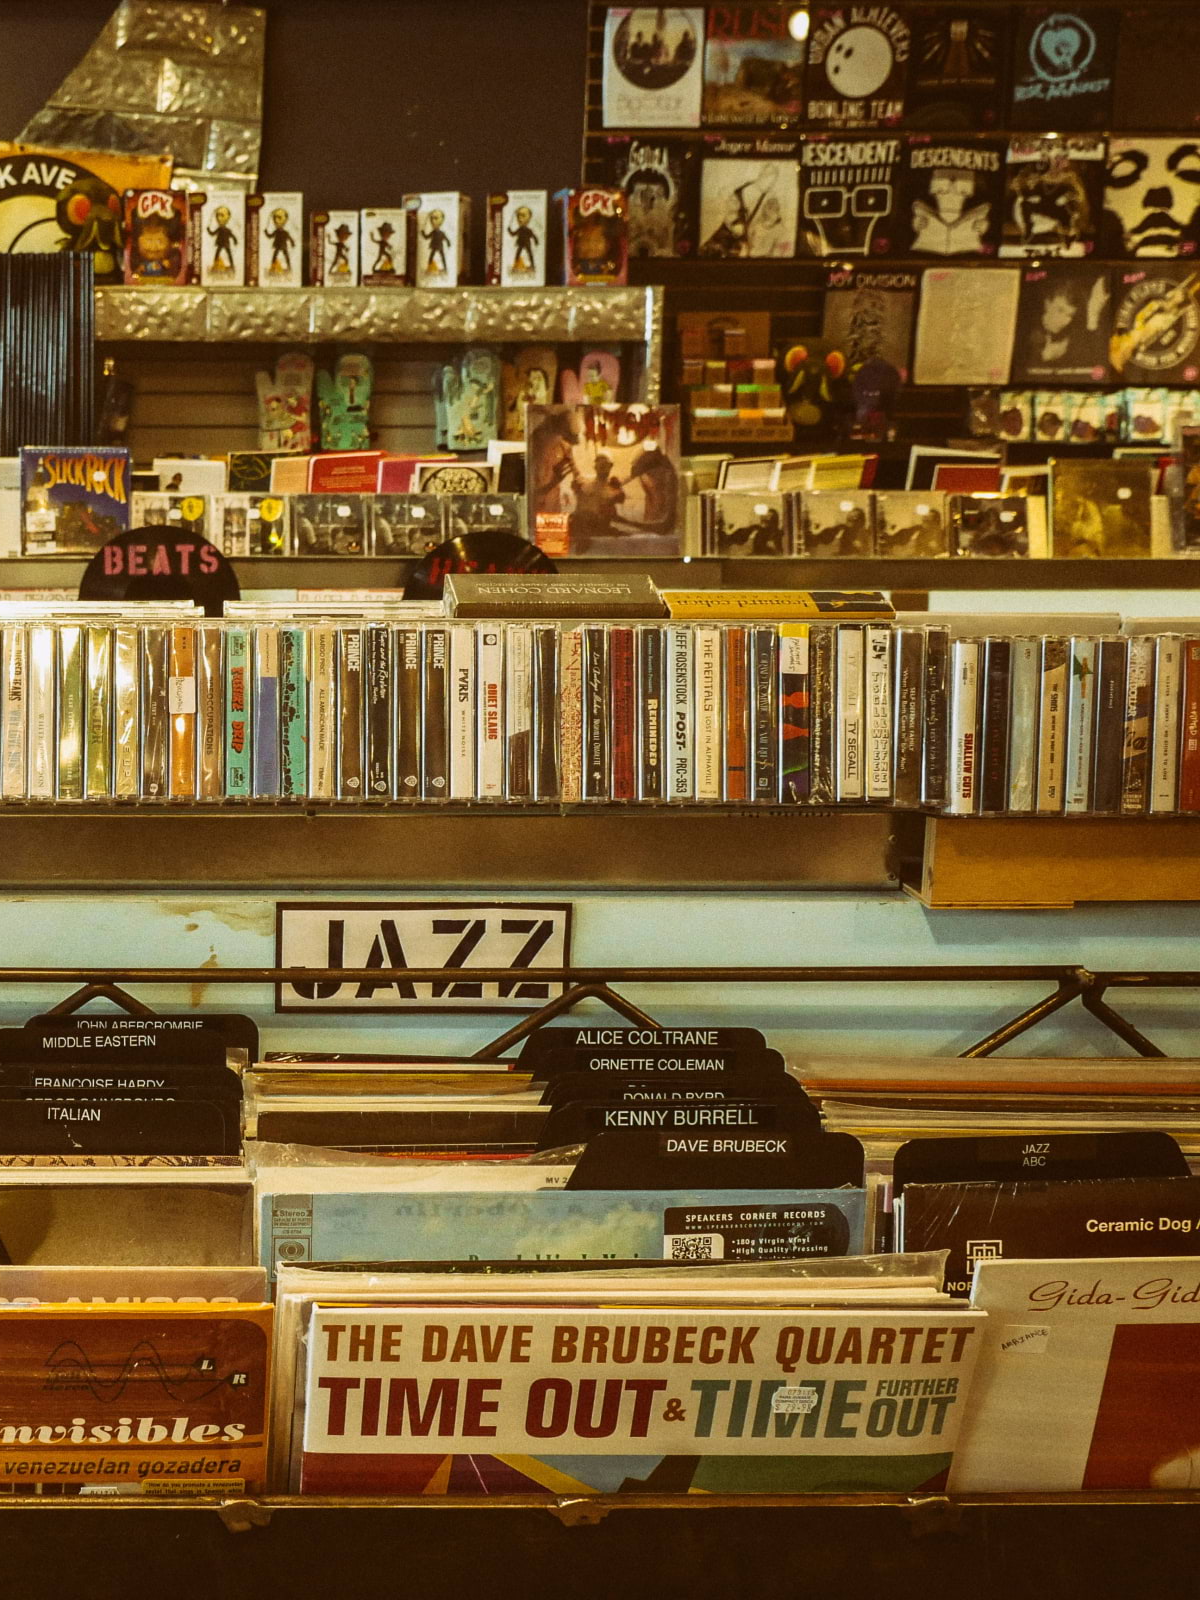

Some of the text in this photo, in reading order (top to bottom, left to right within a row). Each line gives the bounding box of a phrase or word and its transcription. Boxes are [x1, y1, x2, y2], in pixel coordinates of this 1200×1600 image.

[910, 146, 1000, 172] DESCENDENTS
[22, 162, 78, 190] AVE
[826, 271, 916, 287] JOY DIVISION
[104, 544, 219, 576] BEATS
[478, 586, 541, 594] COHEN
[348, 634, 359, 671] PRINCE
[405, 633, 416, 670] PRINCE
[433, 634, 444, 669] PRINCE
[703, 639, 713, 658] THE
[8, 679, 22, 701] JEANS
[459, 668, 469, 703] PVRIS
[703, 662, 713, 712] RENTALS
[488, 684, 497, 740] QUIET SLANG
[676, 631, 687, 793] JEFF ROSENSTOCK PRC-353
[1050, 694, 1058, 712] SHINS
[231, 721, 245, 754] DRIP
[848, 722, 856, 778] TY SEGALL
[963, 733, 972, 798] SHALLOW CUTS
[290, 919, 554, 1000] JAZZ
[42, 1035, 156, 1049] MIDDLE EASTERN
[576, 1031, 718, 1045] ALICE COLTRANE
[589, 1059, 724, 1071] ORNETTE COLEMAN
[47, 1107, 101, 1122] ITALIAN
[604, 1110, 758, 1126] KENNY BURRELL
[666, 1139, 786, 1153] DAVE BRUBECK
[1022, 1143, 1050, 1155] JAZZ
[1022, 1156, 1047, 1167] ABC
[685, 1210, 826, 1223] SPEAKERS CORNER RECORDS
[1086, 1217, 1192, 1234] Ceramic Dog
[758, 1238, 785, 1246] Virgin
[758, 1245, 828, 1254] Quality Pressing
[321, 1324, 975, 1373] THE DAVE BRUBECK QUARTET
[875, 1377, 959, 1398] FURTHER
[317, 1377, 957, 1439] TIME OUT & TIME OUT
[3, 1456, 132, 1475] venezuelan
[136, 1456, 242, 1478] gozadera
